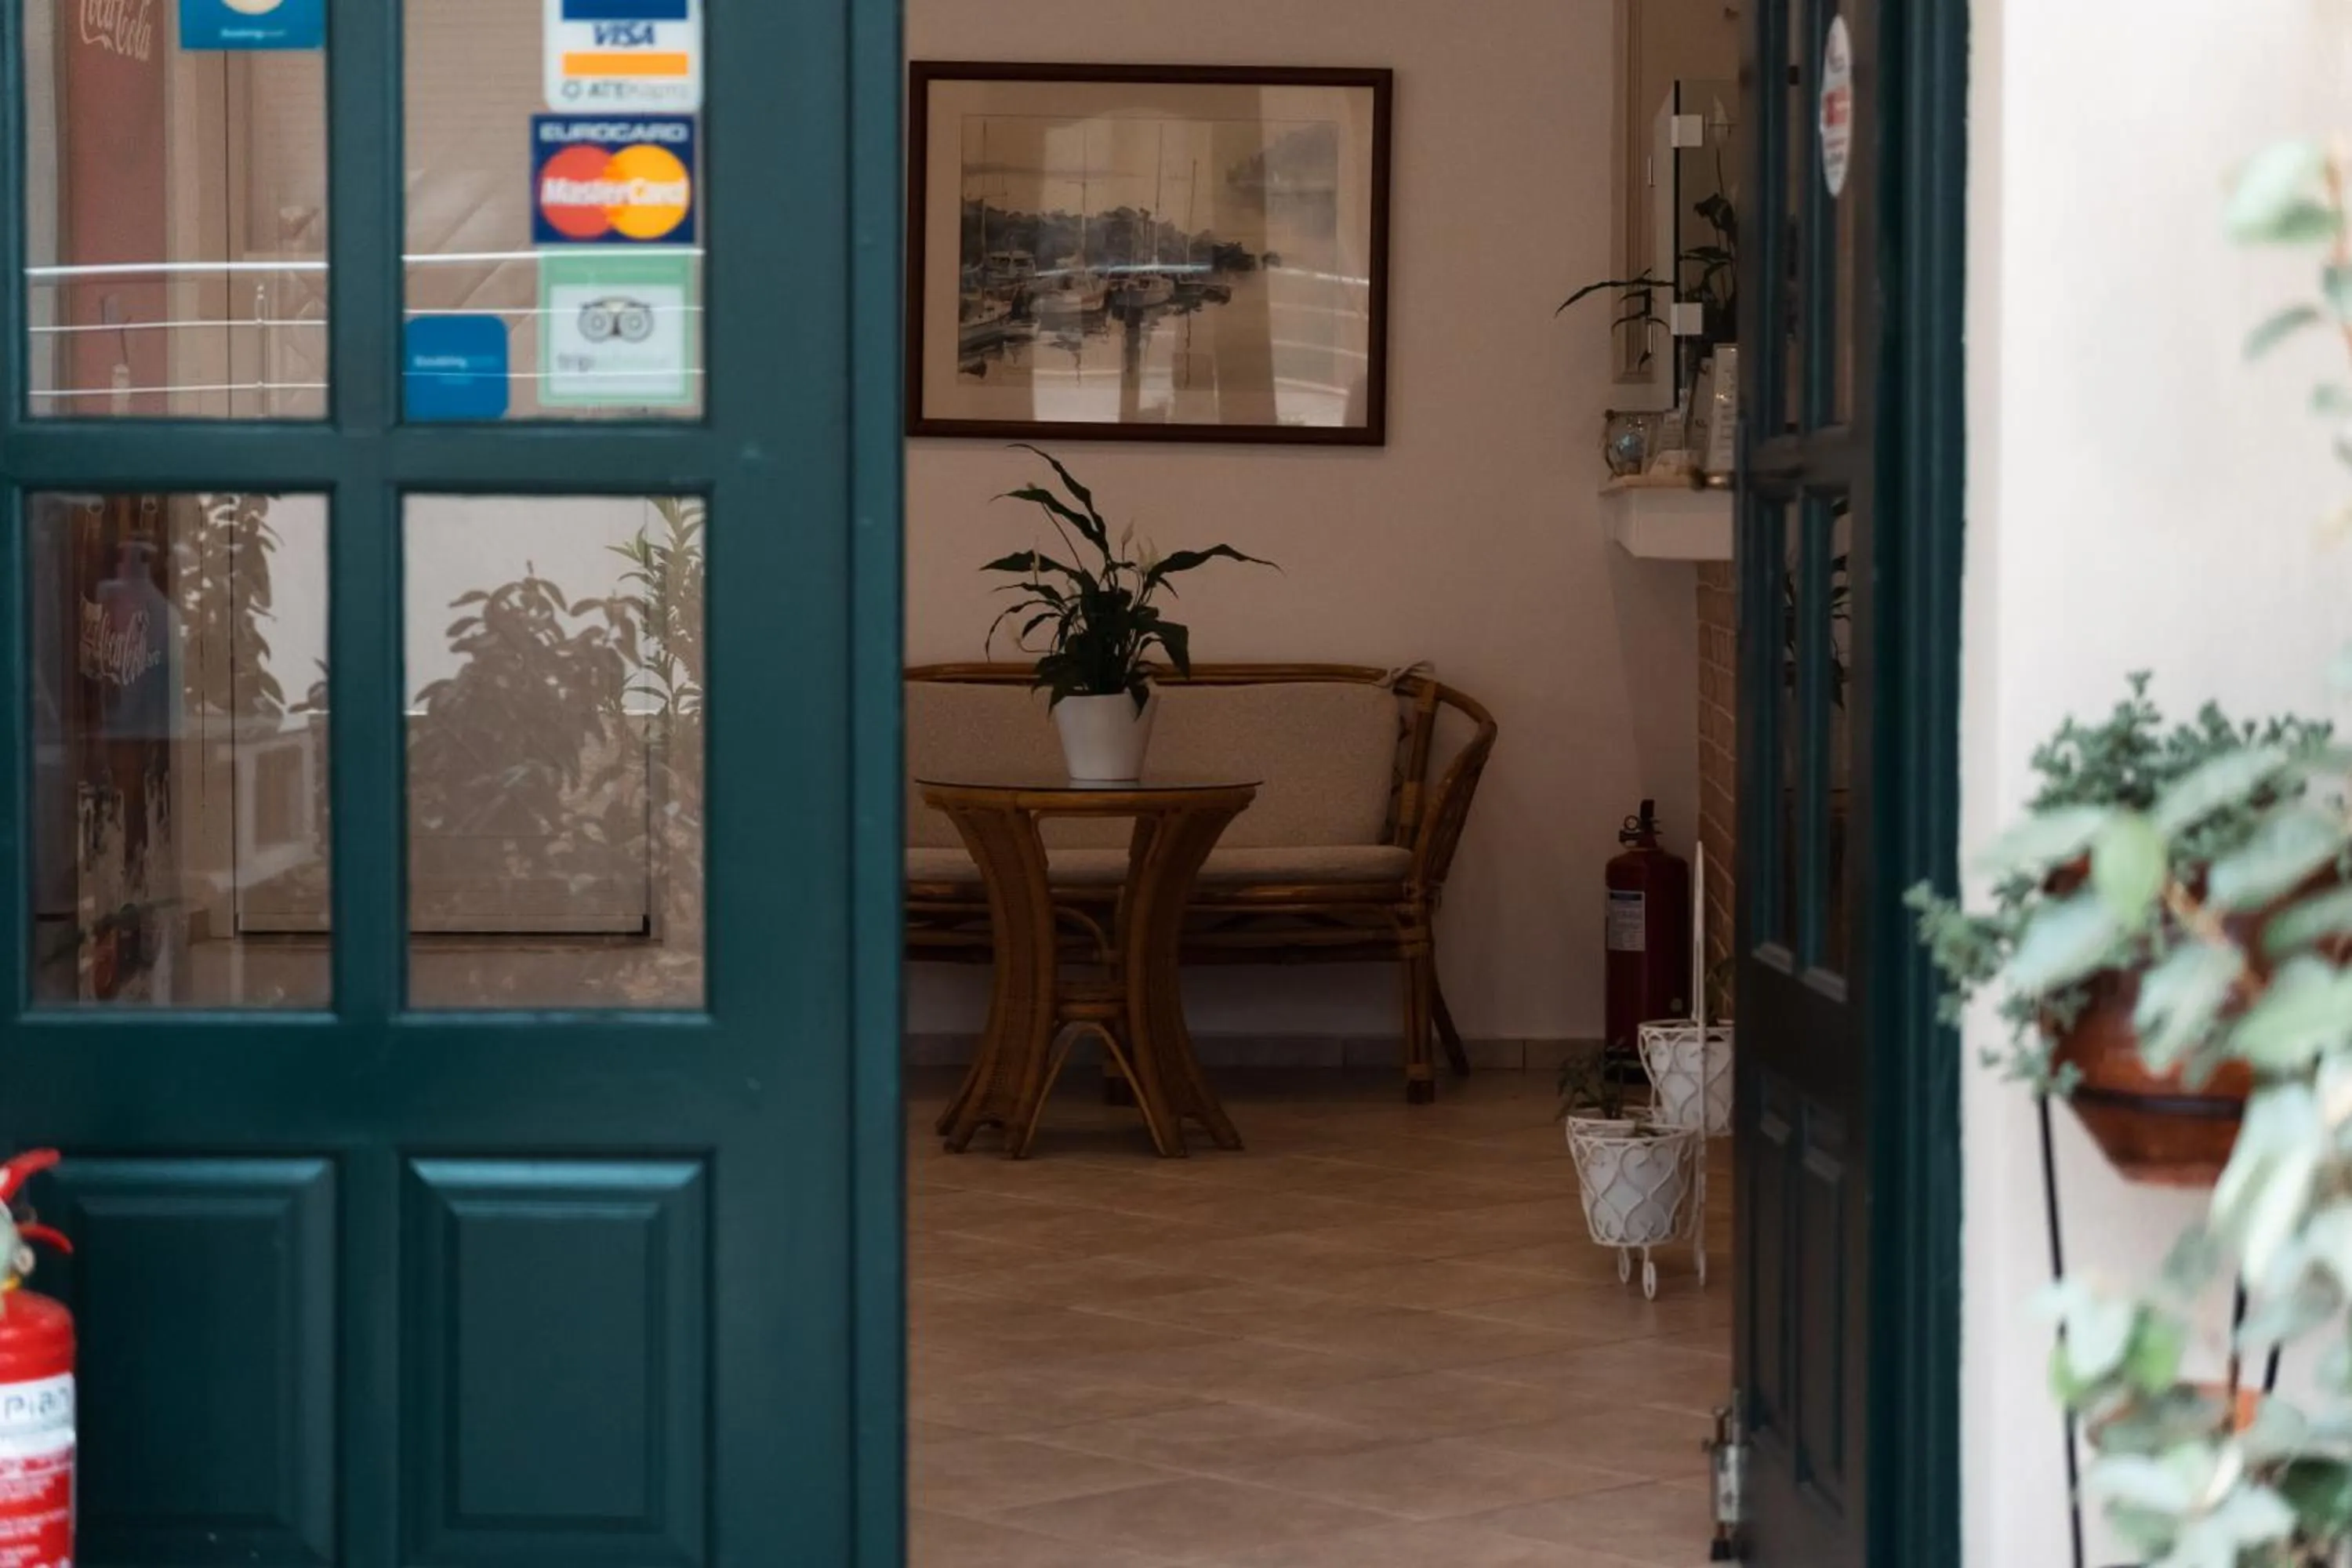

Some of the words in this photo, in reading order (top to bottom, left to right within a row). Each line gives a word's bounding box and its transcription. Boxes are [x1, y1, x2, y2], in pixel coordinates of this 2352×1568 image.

[593, 24, 655, 45] VISA
[539, 123, 689, 142] EUROCARD
[541, 178, 690, 205] MasterCard
